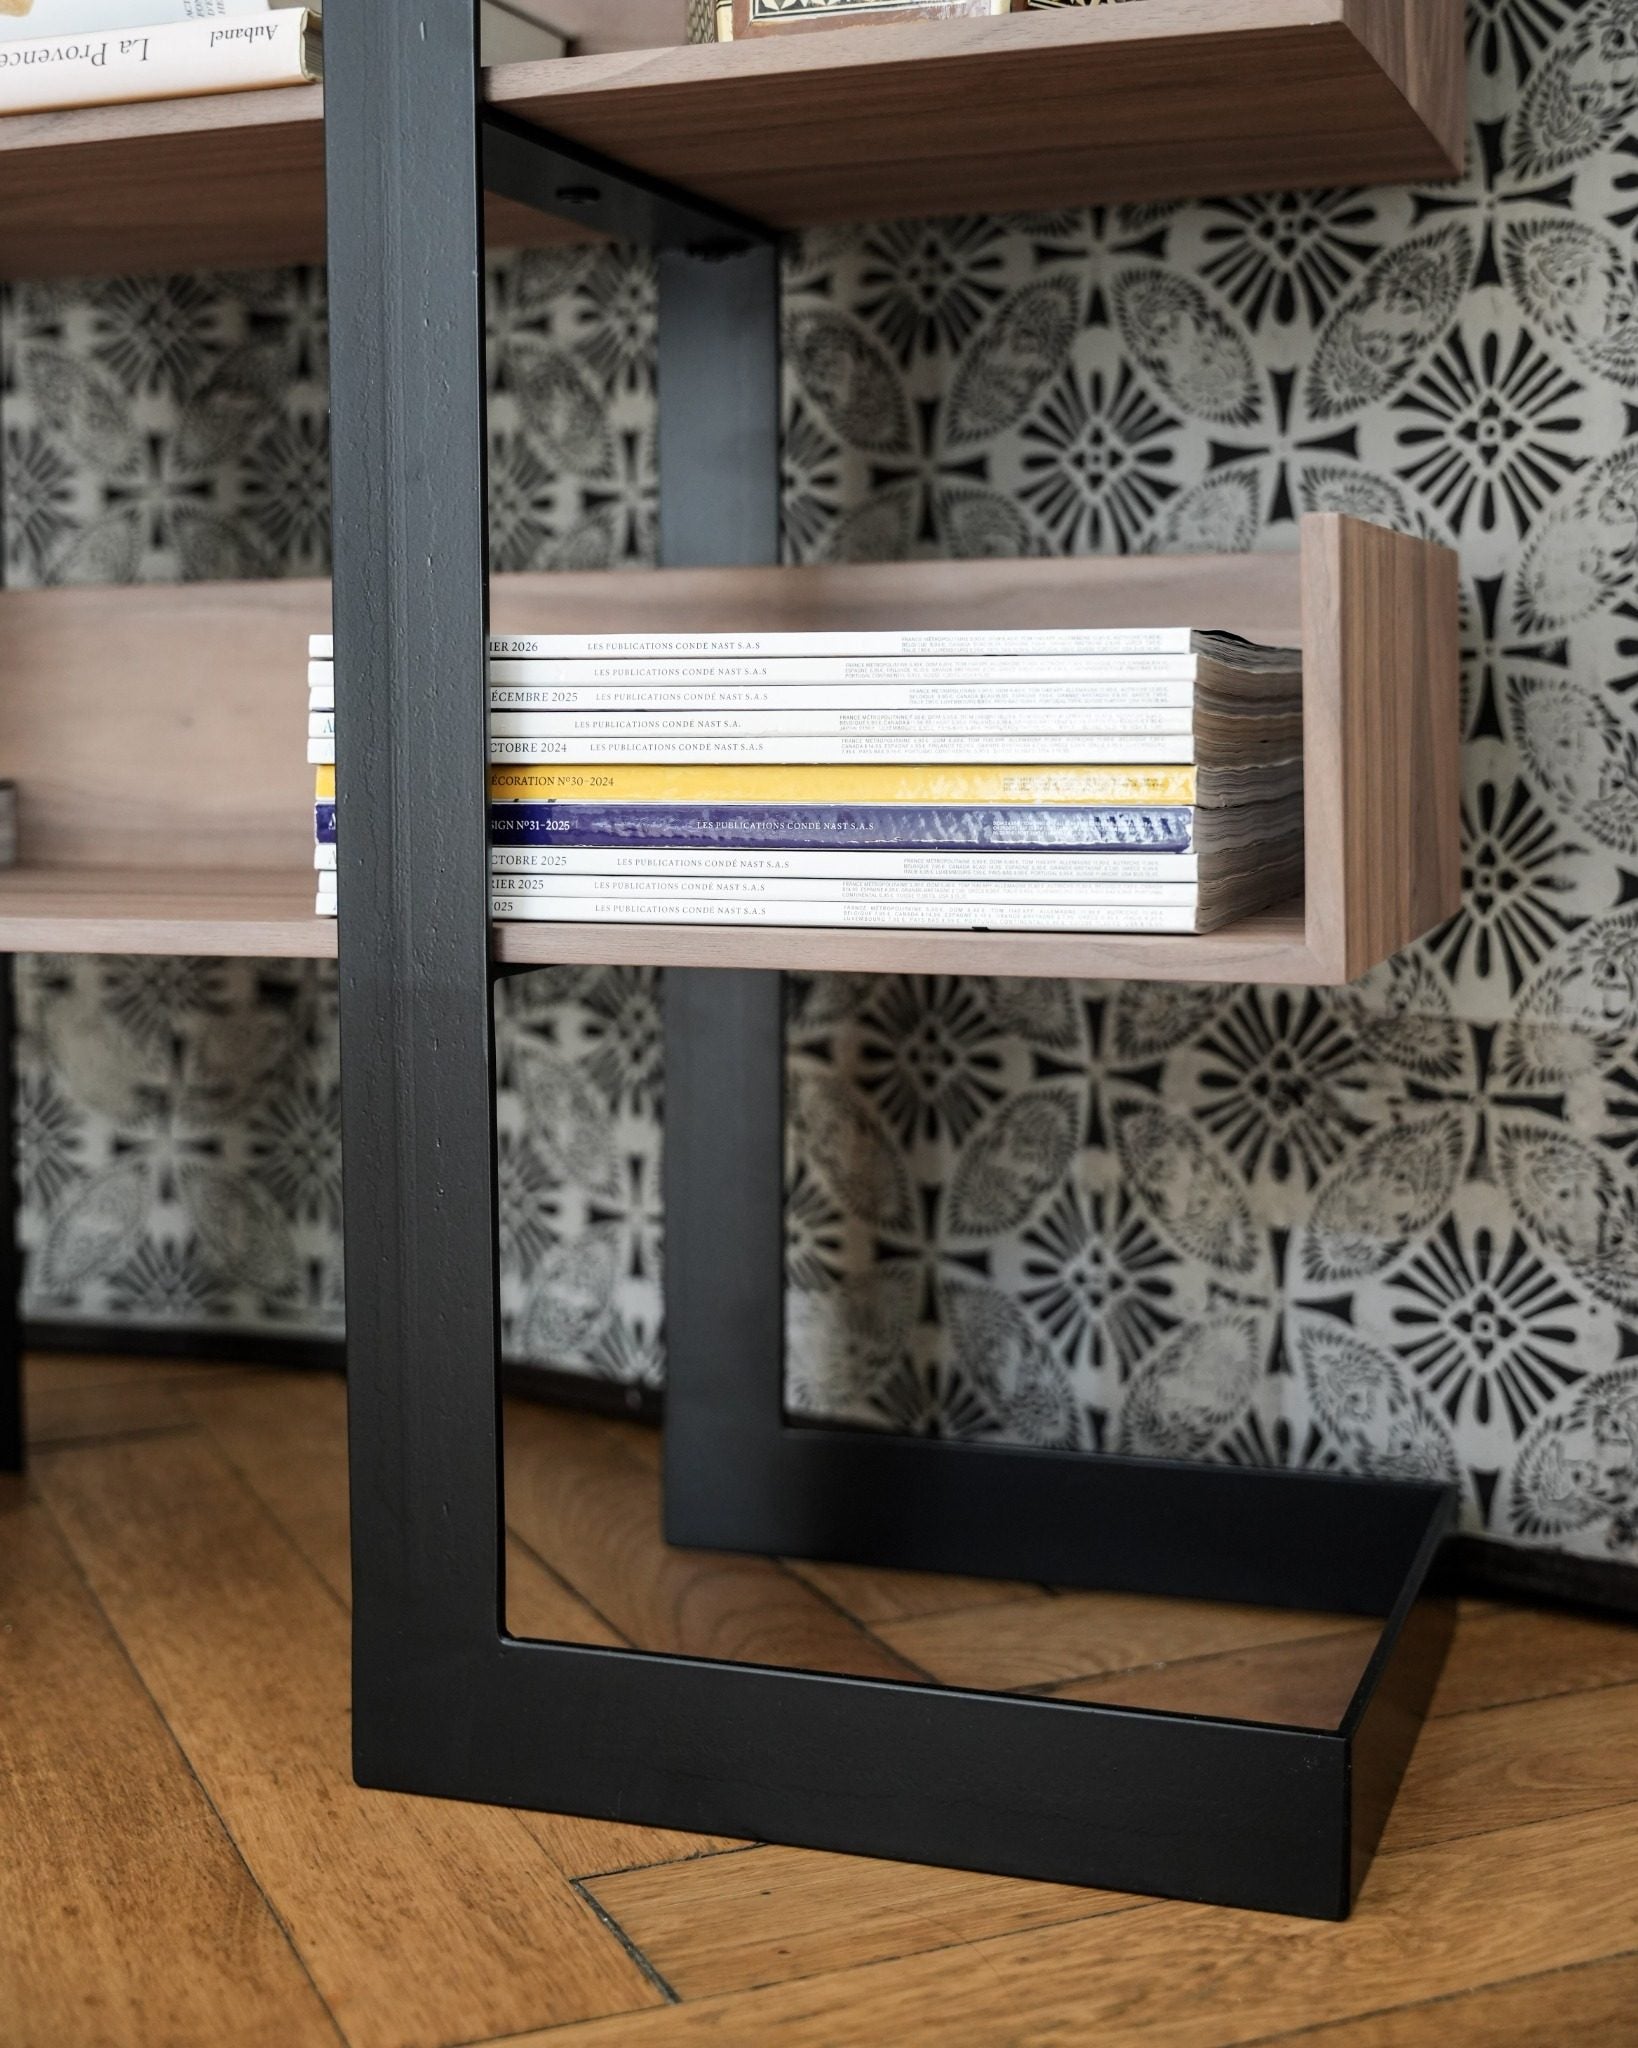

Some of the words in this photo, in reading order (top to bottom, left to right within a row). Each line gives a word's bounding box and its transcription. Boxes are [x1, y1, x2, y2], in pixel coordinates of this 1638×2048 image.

[209, 24, 279, 48] Aubanel
[0, 43, 107, 67] Provence
[120, 39, 149, 62] La
[511, 642, 539, 652] 2026
[587, 642, 604, 650] LES
[606, 642, 673, 650] PUBLICATIONS
[711, 641, 735, 649] NAST
[594, 668, 610, 676] LES
[612, 668, 680, 676] PUBLICATIONS
[718, 668, 742, 676] NAST
[551, 692, 578, 702] 2025
[596, 693, 612, 701] LES
[615, 693, 681, 701] PUBLICATIONS
[719, 693, 743, 701] NAST
[574, 721, 590, 729] LES
[593, 721, 660, 729] PUBLICATIONS
[698, 720, 722, 728] NAST
[540, 743, 567, 753] 2024
[590, 743, 605, 751] LES
[608, 743, 676, 751] PUBLICATIONS
[714, 743, 738, 751] NAST
[697, 821, 713, 830] LES
[716, 821, 786, 830] PUBLICATIONS
[823, 822, 848, 831] NAST
[540, 856, 567, 866] 2025
[617, 859, 632, 867] LES
[635, 860, 702, 868] PUBLICATIONS
[740, 861, 764, 869] NAST
[518, 880, 544, 890] 2025
[594, 882, 610, 890] LES
[612, 883, 680, 891] PUBLICATIONS
[716, 884, 740, 892] NAST
[595, 905, 611, 913] LES
[614, 906, 680, 914] PUBLICATIONS
[717, 907, 741, 915] NAST
